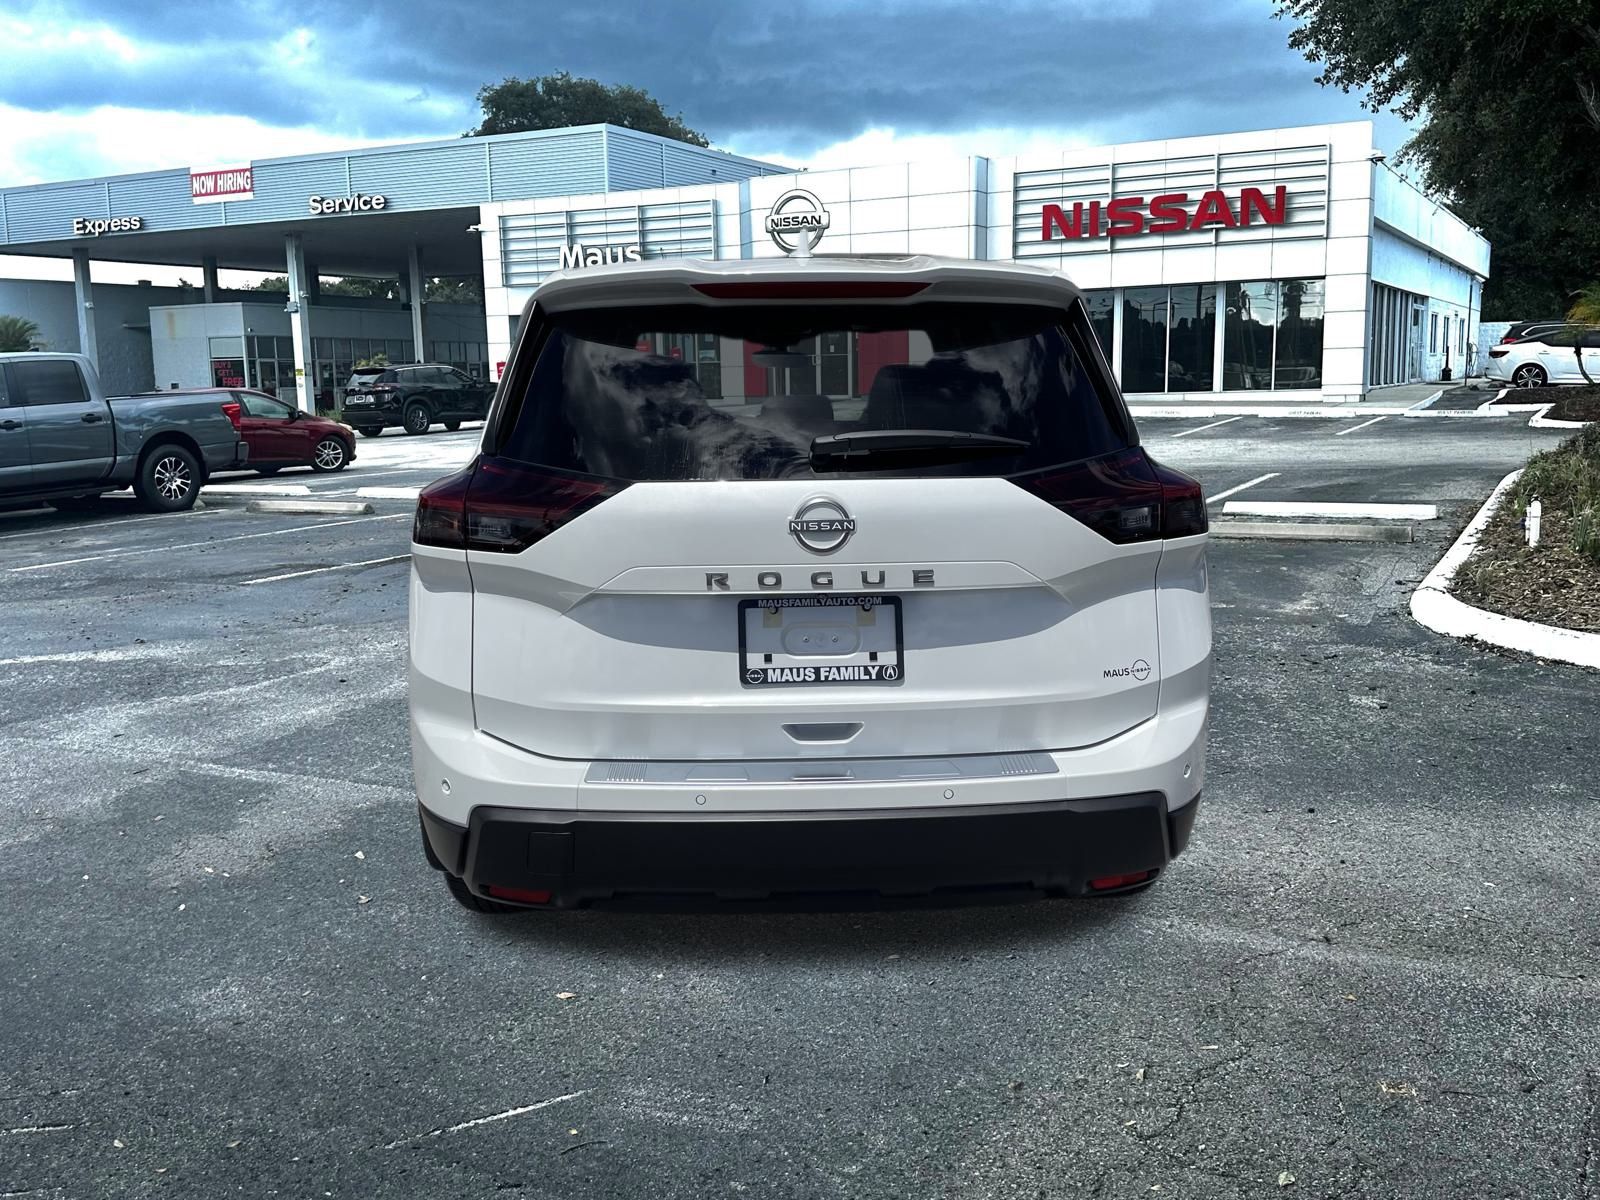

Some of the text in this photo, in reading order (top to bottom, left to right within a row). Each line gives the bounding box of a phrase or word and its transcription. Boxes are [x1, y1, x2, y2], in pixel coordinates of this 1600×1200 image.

[192, 170, 251, 195] NOW HIRING
[309, 193, 385, 215] Service
[1041, 185, 1287, 242] NISSAN
[73, 216, 141, 237] Express
[770, 214, 822, 228] NISSAN
[559, 243, 642, 269] Maus
[222, 376, 244, 387] FREE
[790, 519, 855, 532] NISSAN
[705, 569, 935, 590] ROGUE
[757, 596, 883, 608] MAUSFAMILYAUTO.COM
[767, 668, 815, 683] MAUS
[820, 666, 880, 681] FAMILY
[1103, 667, 1130, 678] MAUS
